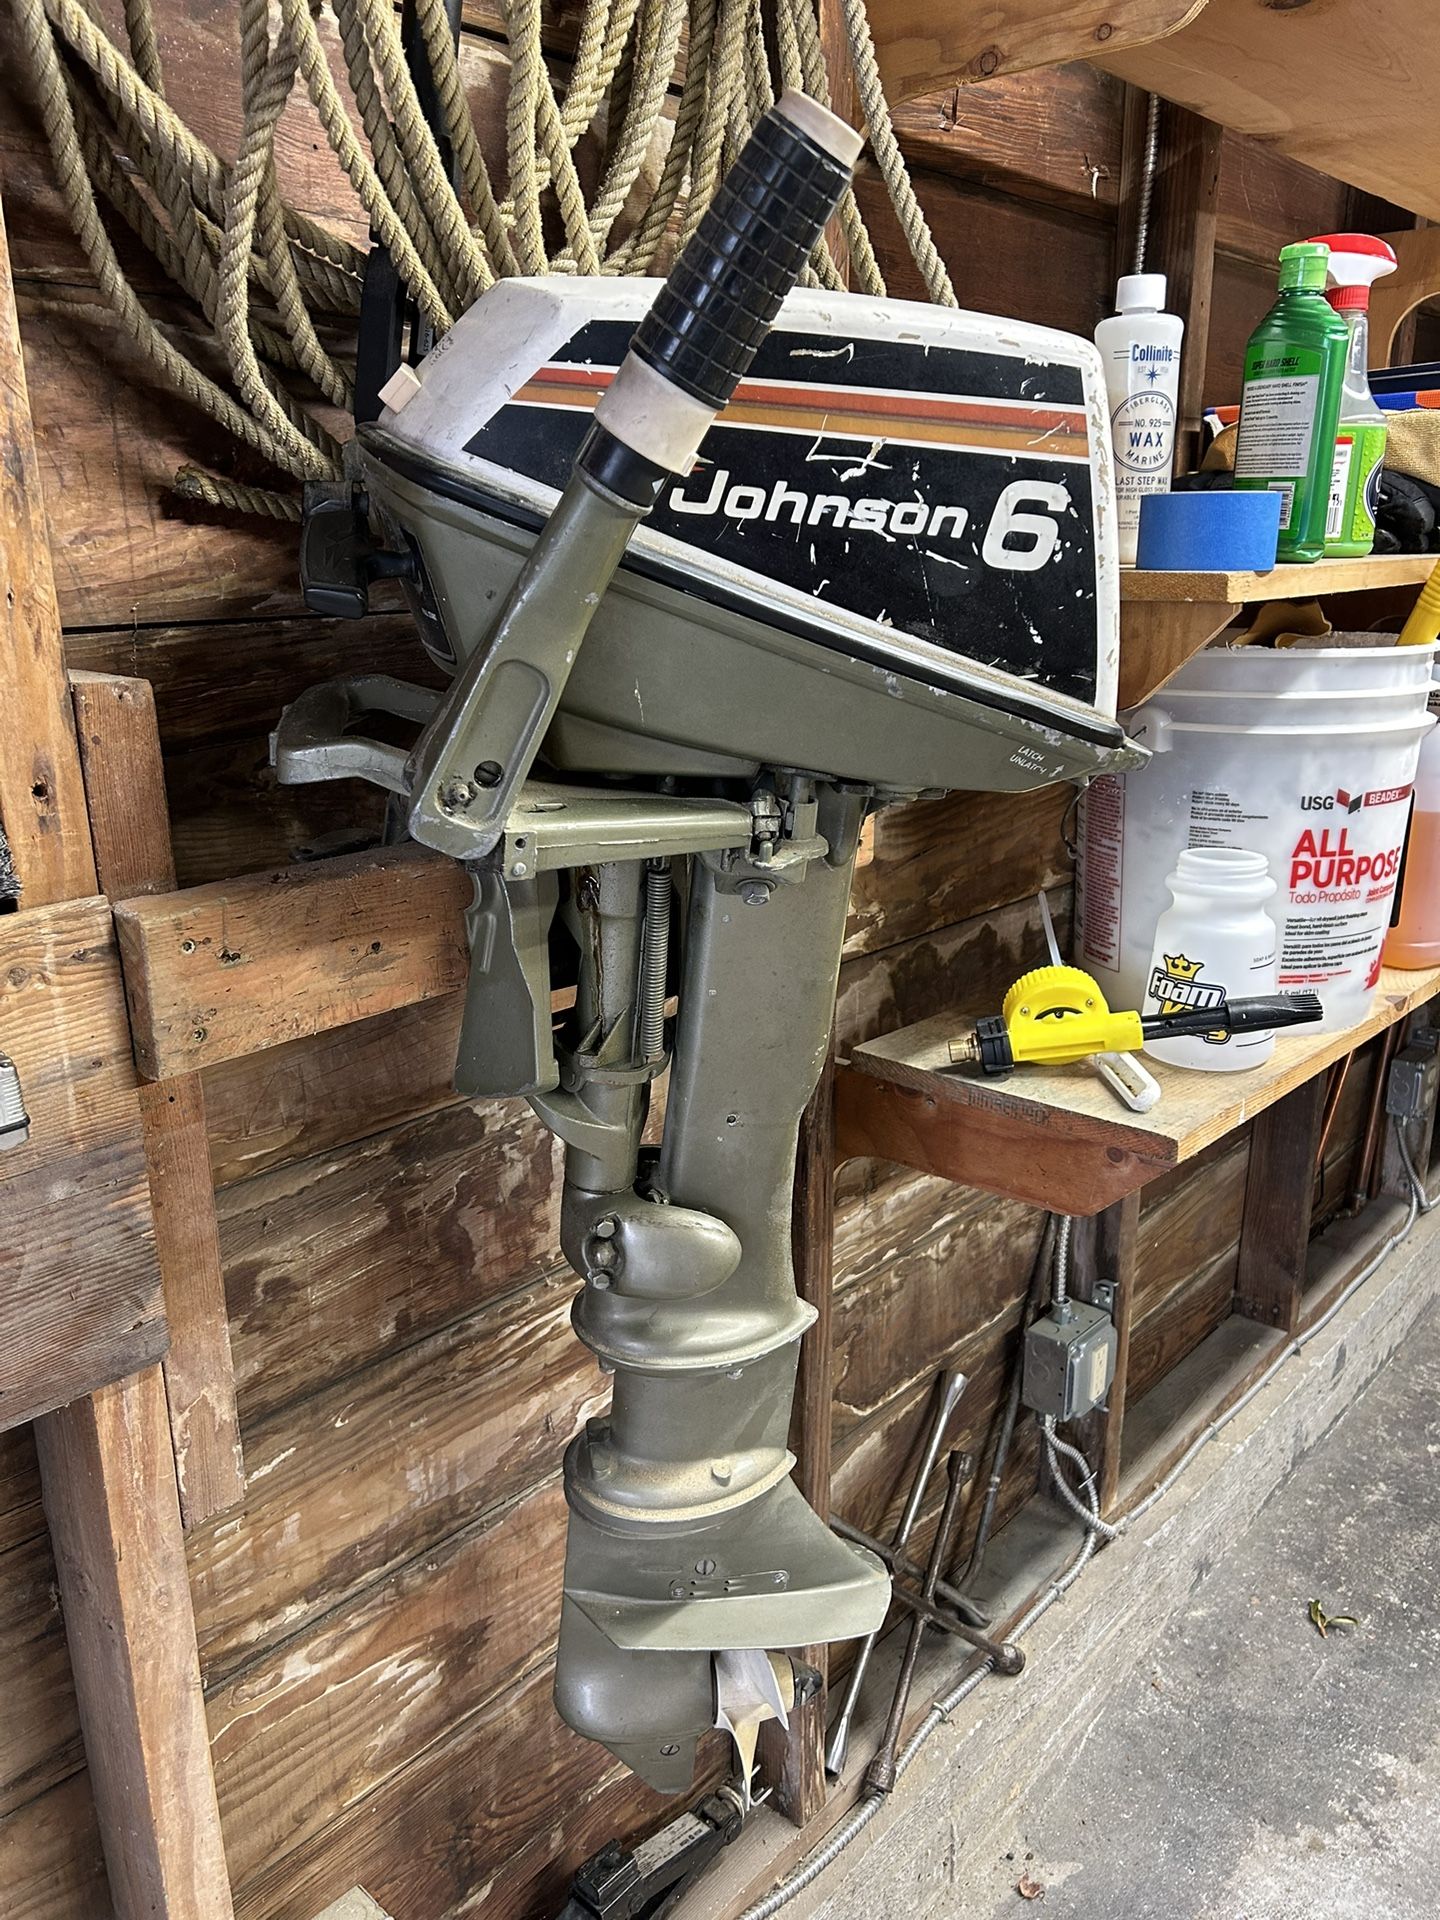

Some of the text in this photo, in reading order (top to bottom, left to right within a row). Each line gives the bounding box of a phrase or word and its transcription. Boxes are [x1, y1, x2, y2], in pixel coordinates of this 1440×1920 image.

[1132, 344, 1173, 361] Collinite
[1125, 397, 1170, 413] FIBERGLASS
[1135, 419, 1162, 427] NO. 925
[1130, 432, 1163, 447] WAX
[1126, 450, 1165, 464] MARINE
[1115, 476, 1135, 486] LAST
[1137, 476, 1156, 485] STEP
[669, 470, 1070, 571] Johnson 6
[1018, 746, 1045, 762] LATCH
[1300, 789, 1400, 811] USG BEADEX
[1292, 828, 1354, 858] ALL
[1289, 846, 1401, 889] PURPOSE
[1289, 891, 1317, 904] Todo
[1317, 889, 1361, 903] Propósito
[1150, 970, 1222, 1008] Foam
